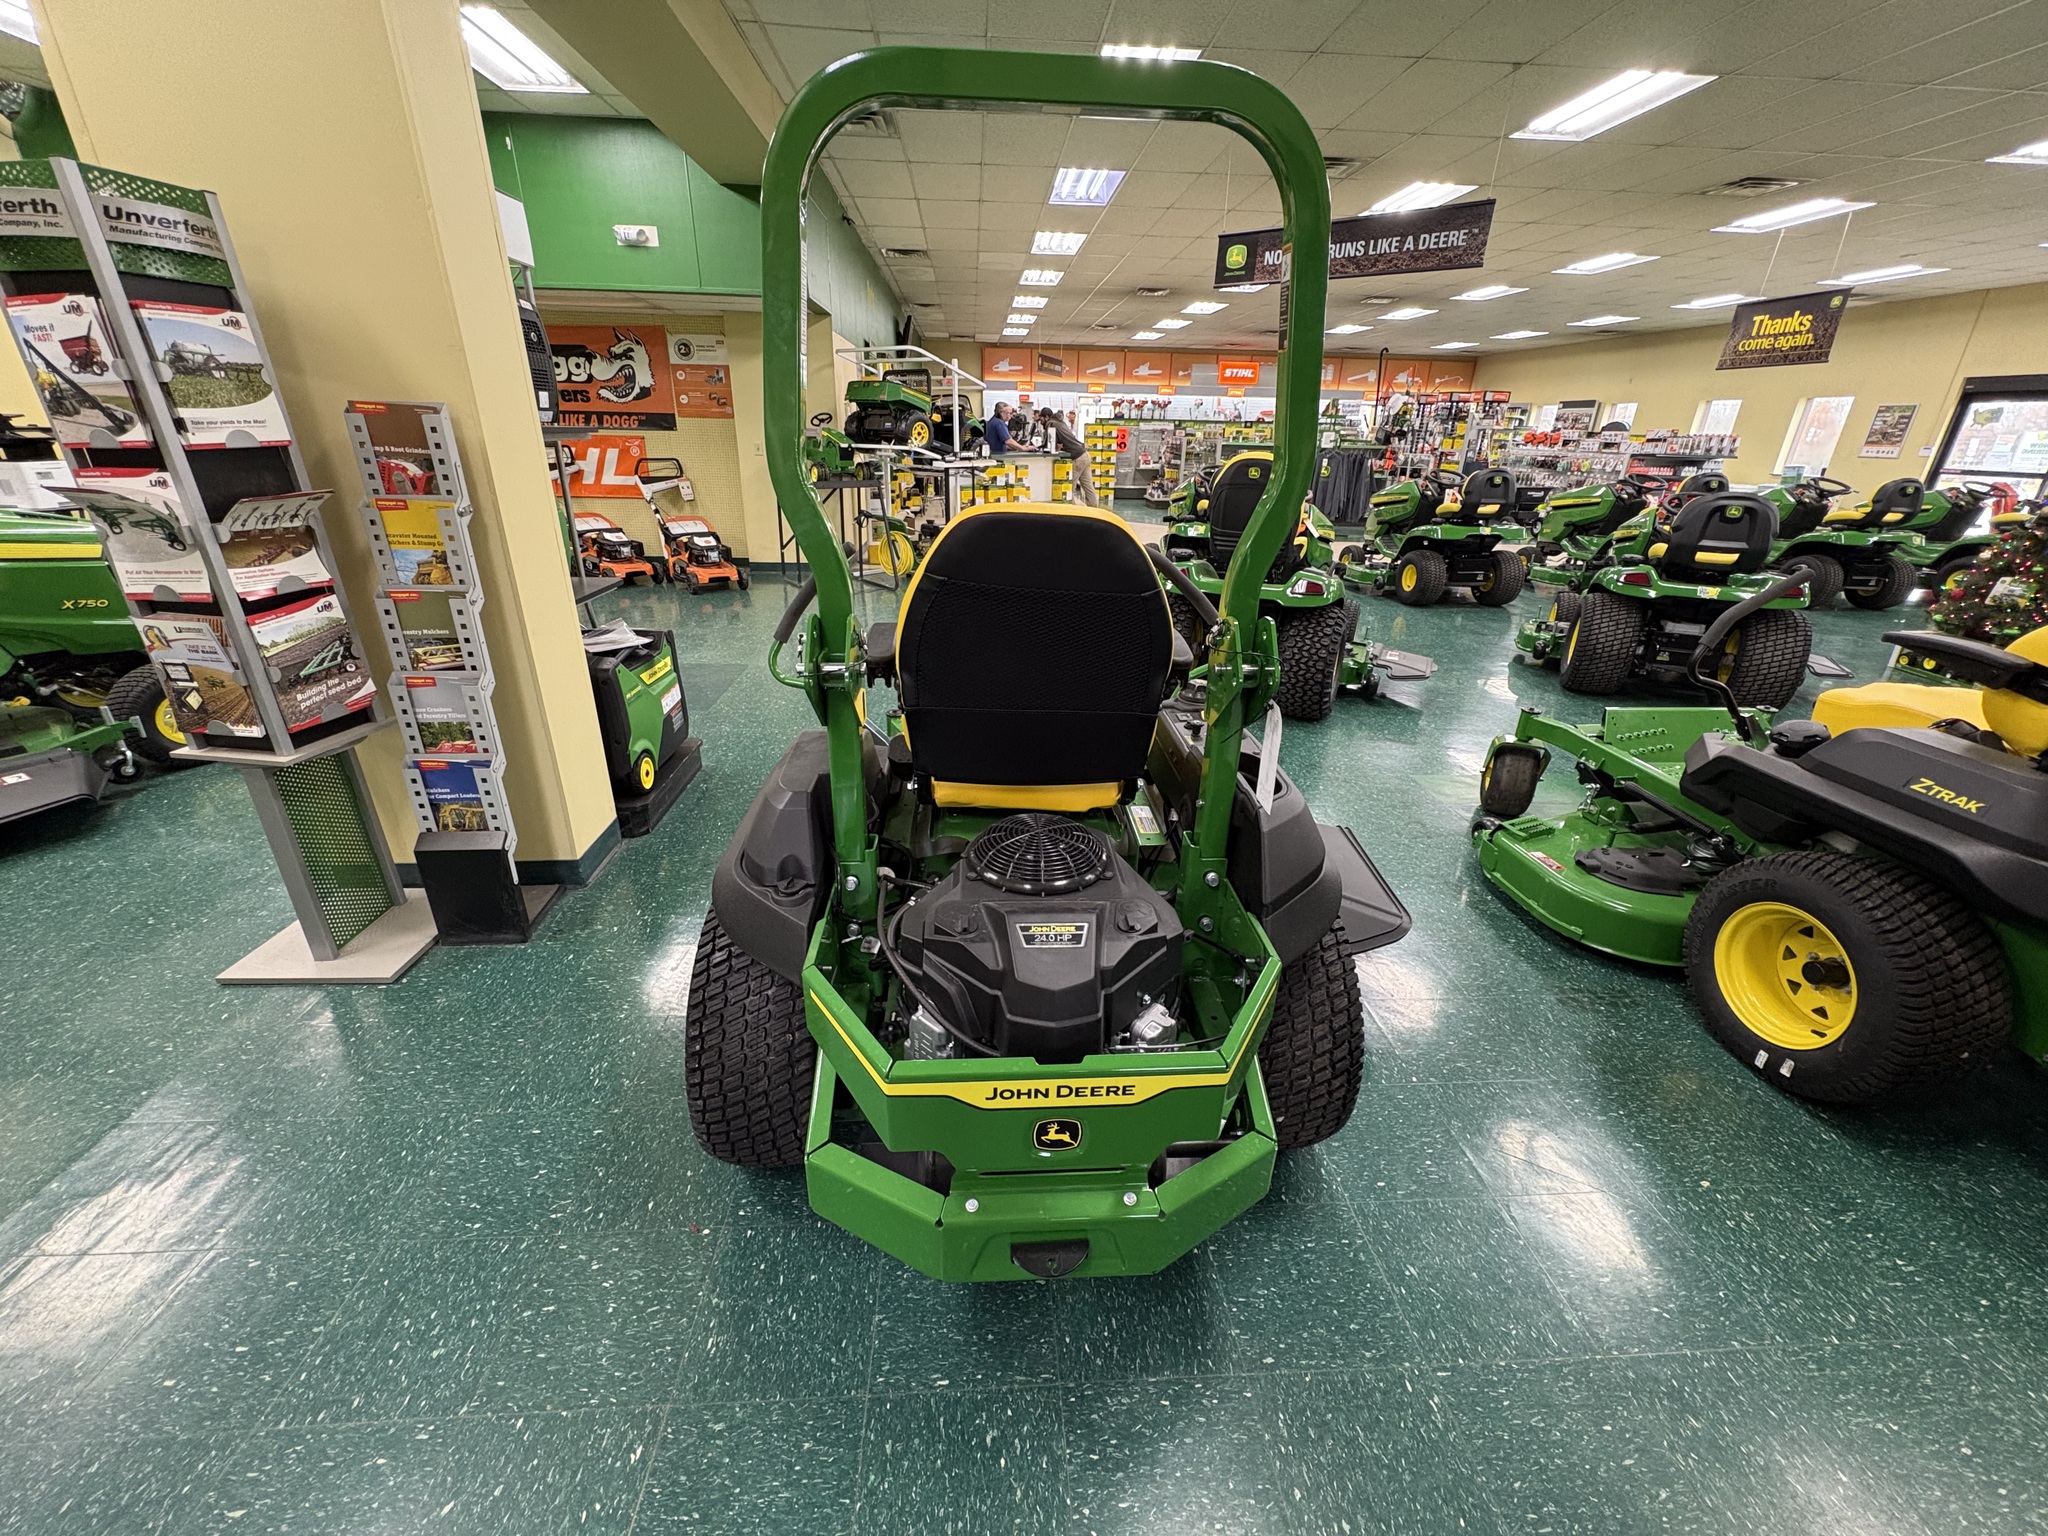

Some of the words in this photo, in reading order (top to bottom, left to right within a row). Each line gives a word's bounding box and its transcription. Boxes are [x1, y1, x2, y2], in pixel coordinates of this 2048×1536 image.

[44, 219, 64, 228] Inc.
[103, 204, 219, 241] Unverferth
[109, 224, 182, 244] Manufacturing
[1329, 241, 1368, 259] RUNS
[1368, 236, 1401, 256] LIKE
[1403, 235, 1415, 251] A
[1418, 230, 1470, 250] DEERE
[23, 323, 48, 334] Moves
[1751, 310, 1814, 337] Thanks
[1738, 336, 1774, 352] come
[1774, 330, 1815, 351] again.
[1223, 367, 1255, 378] STIHL
[558, 413, 586, 427] LIKE
[589, 414, 599, 427] A
[603, 415, 639, 428] DOGG
[296, 683, 327, 701] Building
[327, 677, 340, 688] the
[300, 691, 327, 711] perfect
[328, 684, 346, 696] seed
[346, 675, 362, 688] bed
[1909, 777, 1986, 814] ZTRAK
[1029, 925, 1050, 933] JOHN
[1050, 925, 1077, 933] DEERE
[1034, 934, 1056, 942] 24.0
[1057, 934, 1073, 942] HP
[985, 1087, 1050, 1101] JOHN
[1056, 1084, 1136, 1099] DEERE
